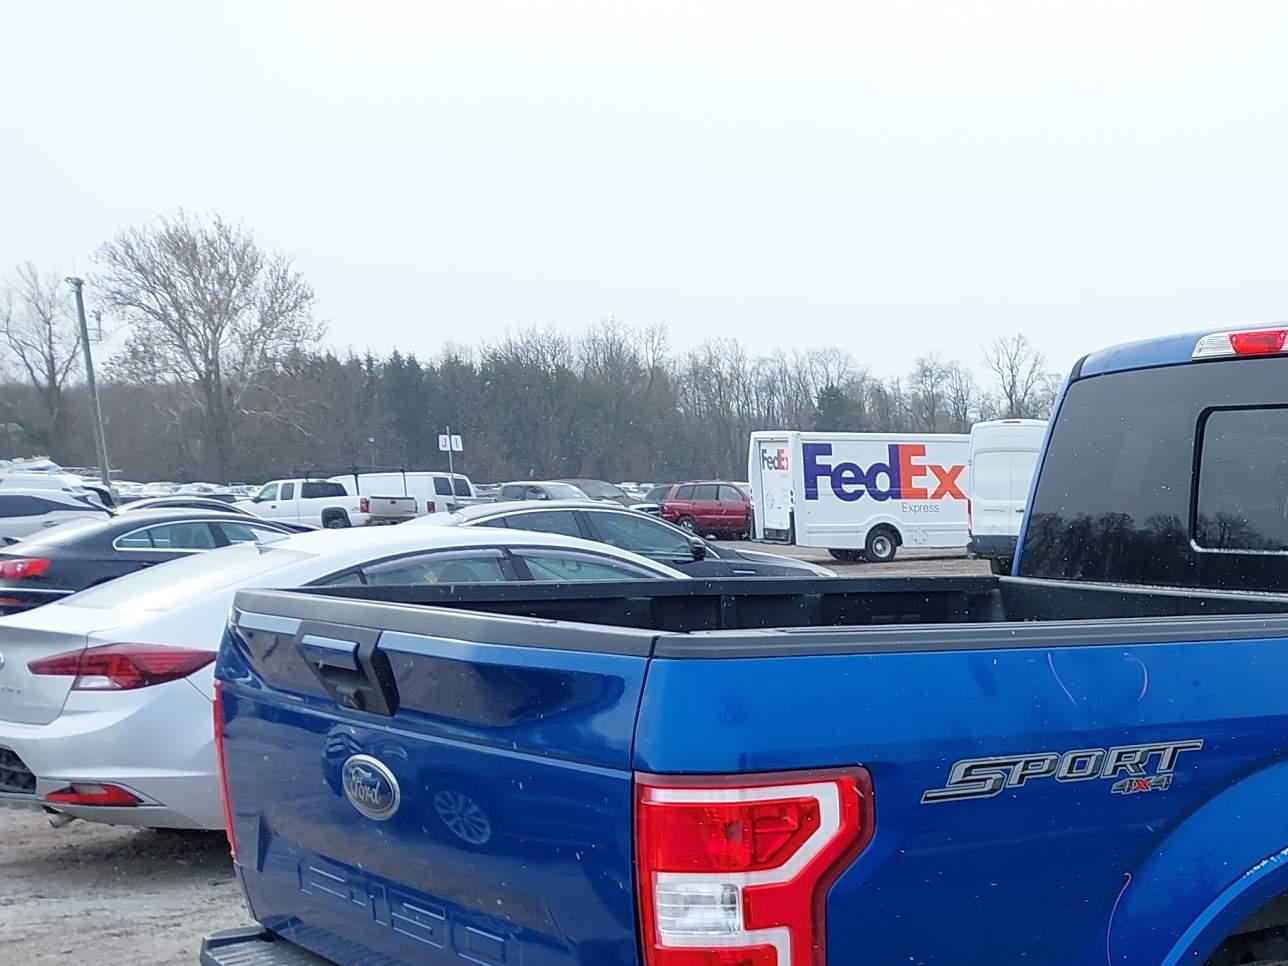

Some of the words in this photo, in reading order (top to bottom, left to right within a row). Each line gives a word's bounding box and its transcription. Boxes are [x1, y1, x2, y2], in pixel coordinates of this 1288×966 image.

[801, 442, 967, 502] FedEx
[902, 502, 940, 514] Express
[349, 766, 382, 806] Ford
[920, 738, 1204, 805] SPORT
